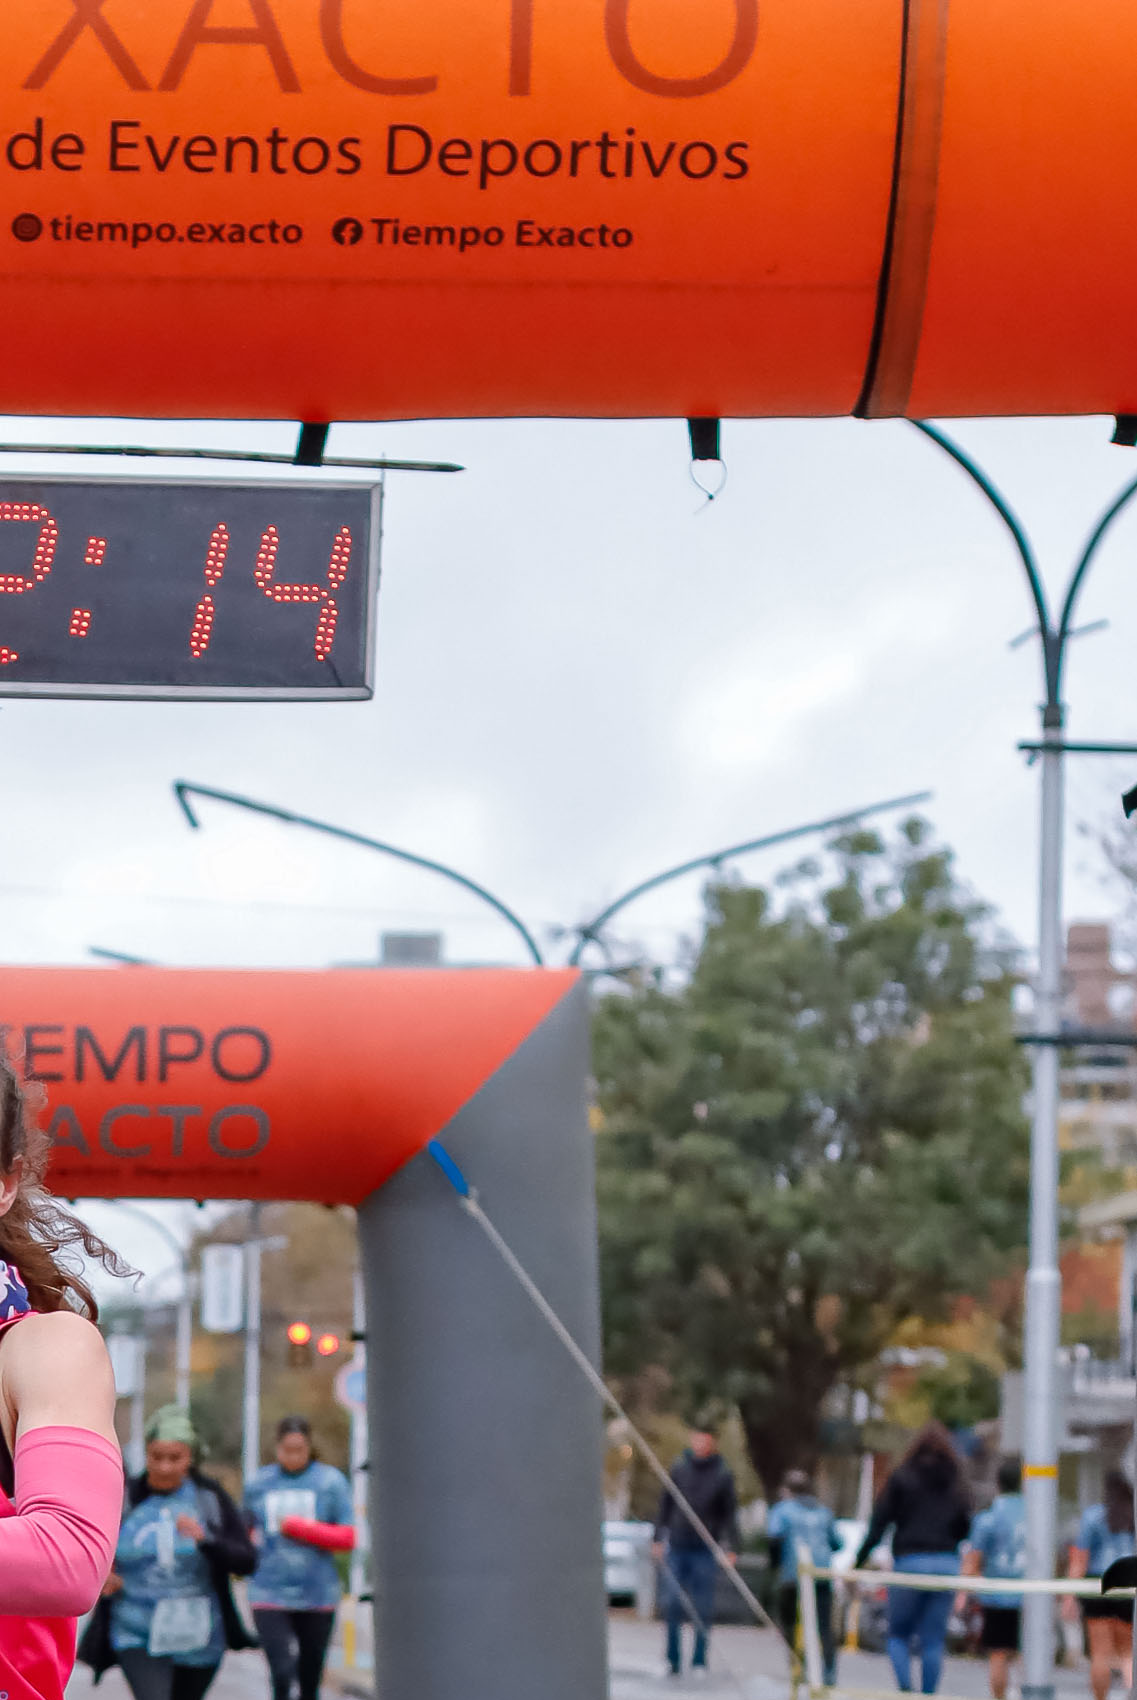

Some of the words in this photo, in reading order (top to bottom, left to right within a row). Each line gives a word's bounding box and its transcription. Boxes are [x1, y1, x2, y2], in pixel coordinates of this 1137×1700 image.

[6, 117, 85, 172] de
[109, 120, 361, 175] Eventos
[386, 124, 749, 190] Deportivos
[50, 214, 303, 248] tiempo.exacto
[371, 218, 504, 252] Tiempo
[515, 220, 633, 248] Exacto
[44, 1104, 272, 1160] ACTO
